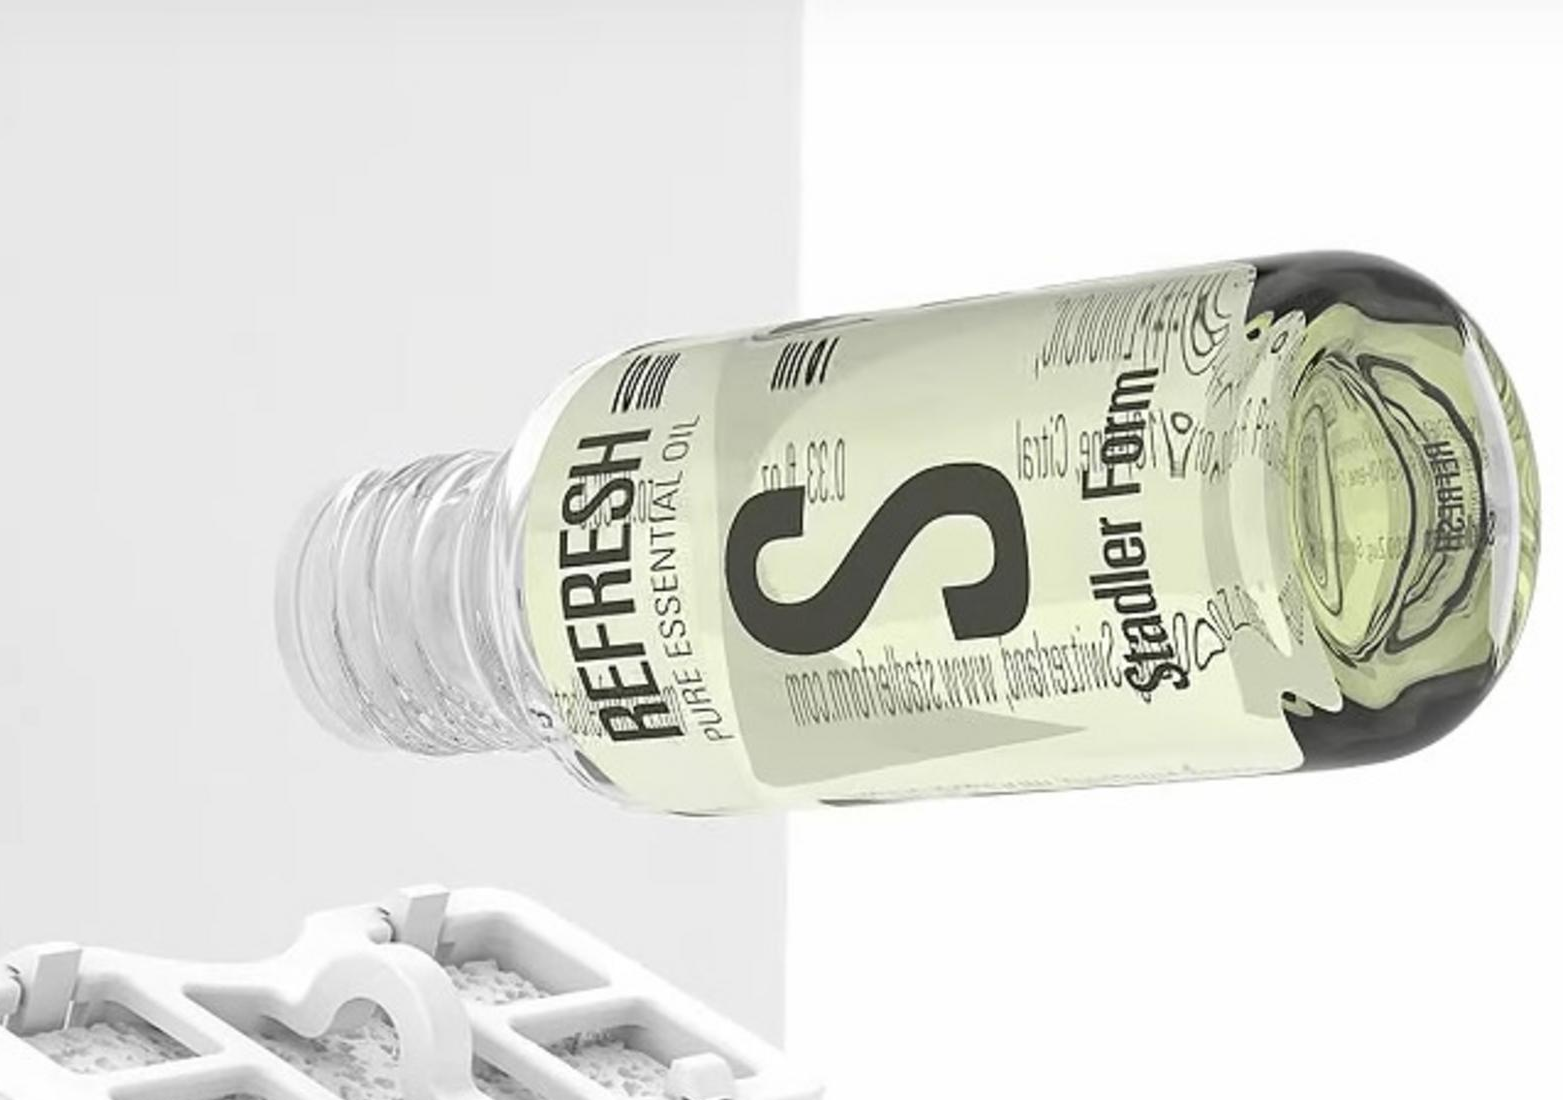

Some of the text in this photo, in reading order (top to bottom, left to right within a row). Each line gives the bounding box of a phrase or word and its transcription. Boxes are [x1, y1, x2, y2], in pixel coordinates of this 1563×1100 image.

[1082, 368, 1159, 499] Form
[559, 427, 684, 741] REFRESH
[648, 414, 734, 742] PURE ESSENTIAL OIL
[724, 461, 1029, 656] S
[1089, 517, 1191, 691] Stadler
